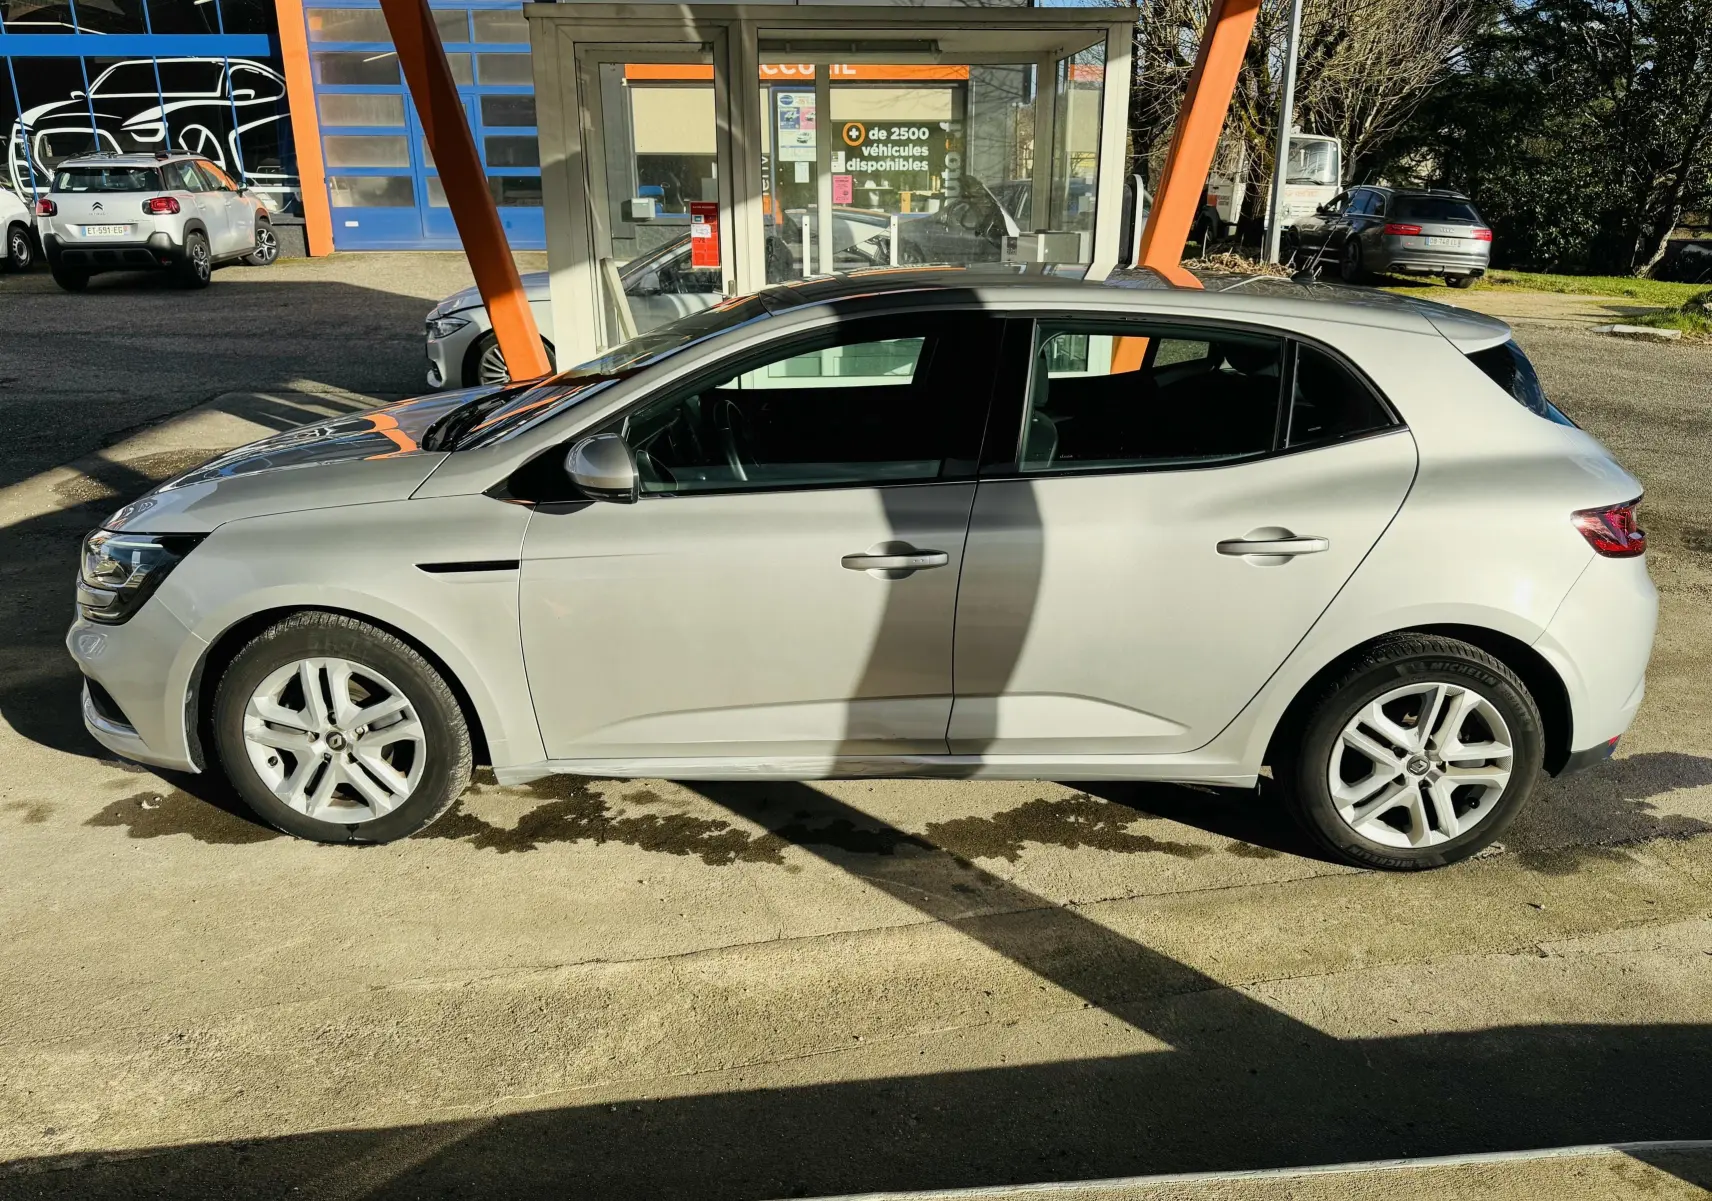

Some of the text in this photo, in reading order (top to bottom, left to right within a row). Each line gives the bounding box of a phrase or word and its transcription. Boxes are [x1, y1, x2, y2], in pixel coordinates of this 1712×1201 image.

[868, 127, 887, 140] de
[890, 127, 930, 140] 2500
[861, 143, 929, 157] véhicules
[846, 157, 929, 173] disponibles
[87, 225, 123, 235] ET-591-EG
[1429, 662, 1498, 687] MICHELIN
[1348, 845, 1414, 868] MICHELIN
